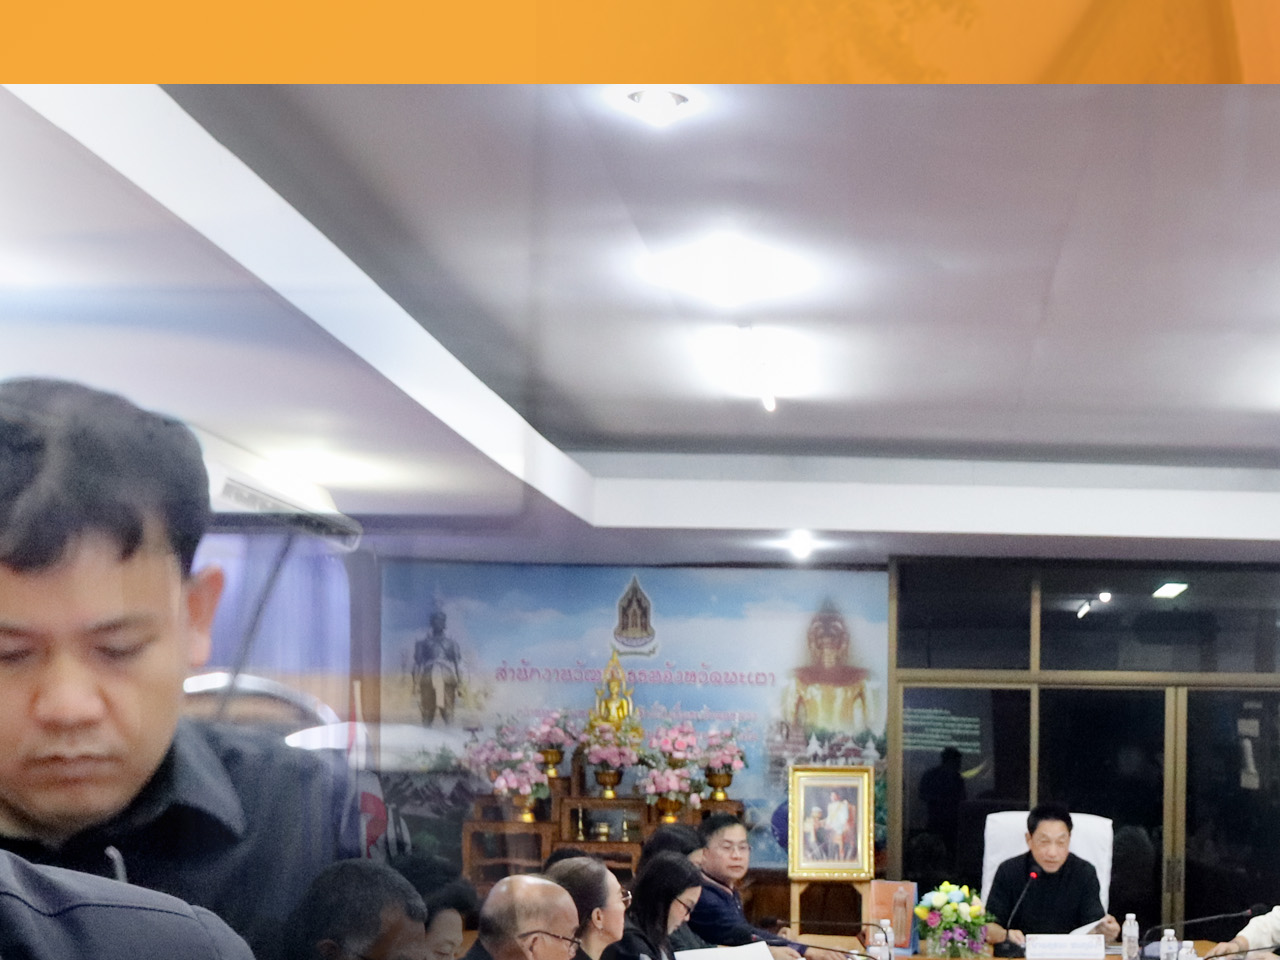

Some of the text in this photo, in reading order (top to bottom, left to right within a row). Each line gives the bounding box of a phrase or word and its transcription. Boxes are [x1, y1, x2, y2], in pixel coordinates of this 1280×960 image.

[495, 659, 776, 687] สำนักงานวัฒธรรมจังหวัดพะเยา
